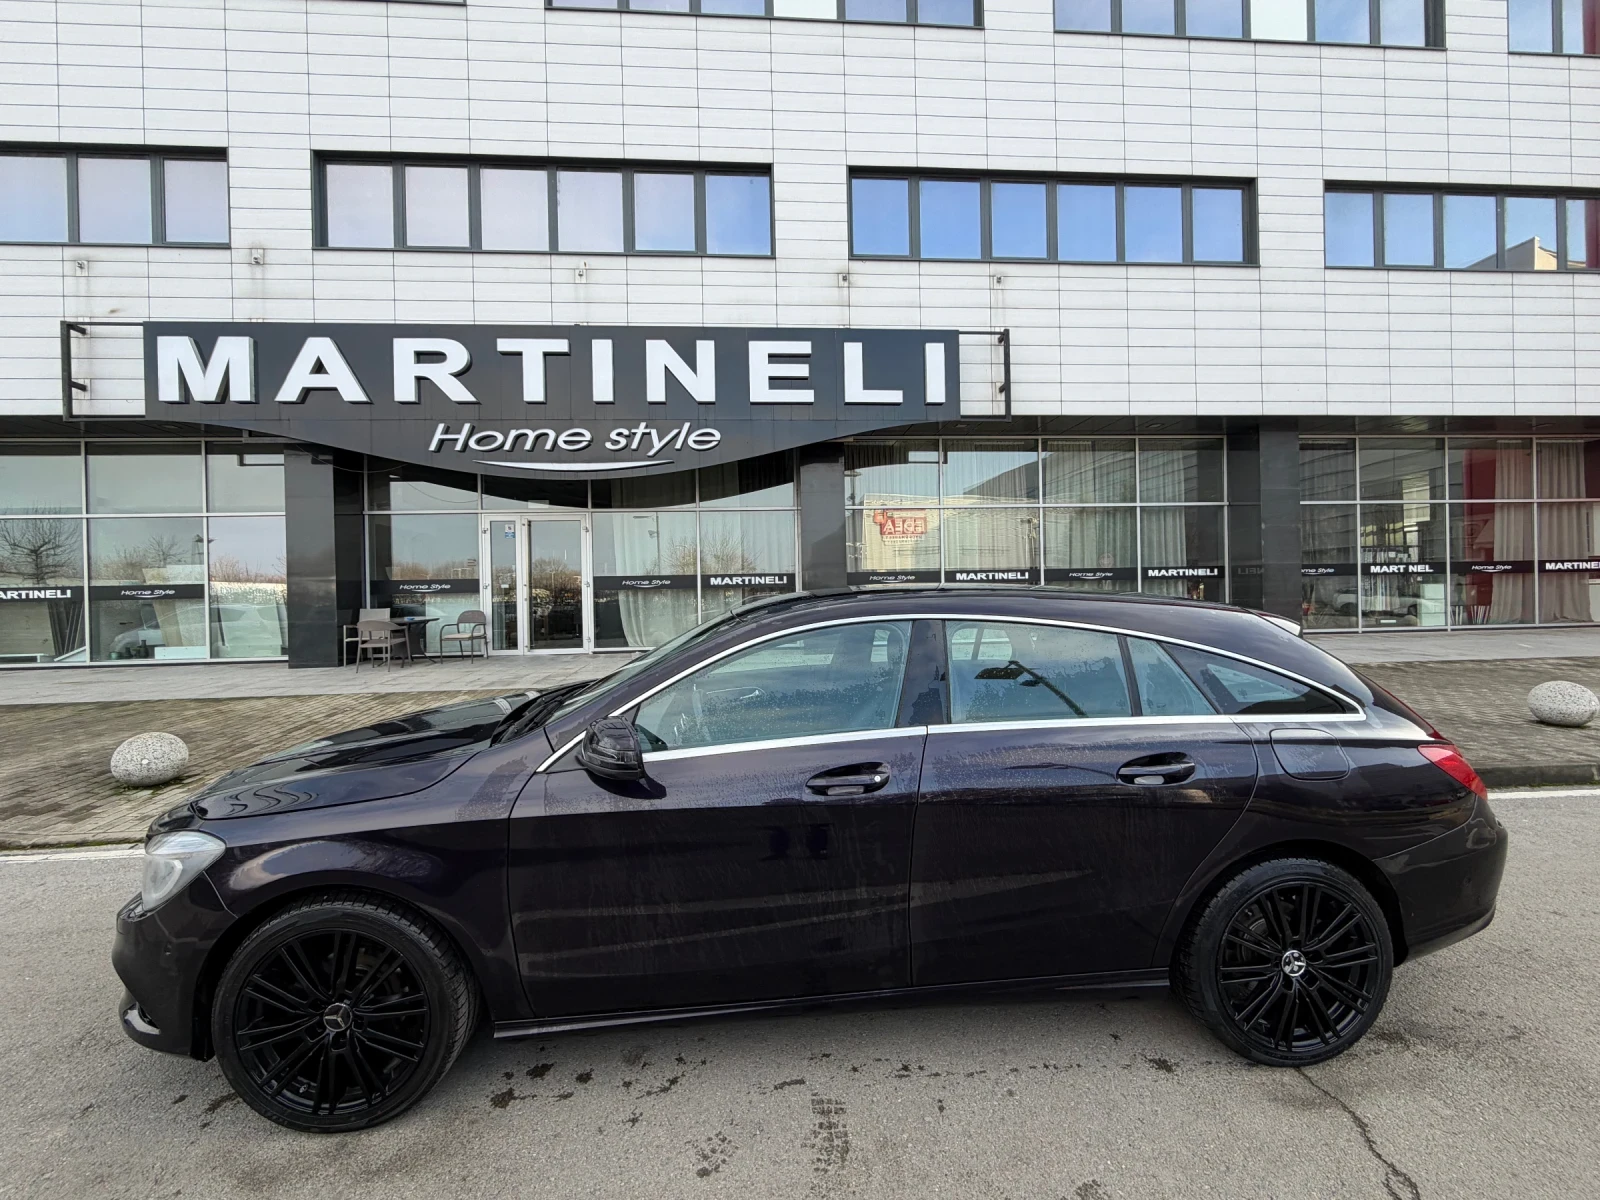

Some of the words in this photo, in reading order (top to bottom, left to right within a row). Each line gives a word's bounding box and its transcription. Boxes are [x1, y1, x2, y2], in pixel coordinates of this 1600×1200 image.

[156, 334, 947, 405] MARTINELI
[428, 422, 592, 452] Home
[604, 421, 722, 457] style
[1545, 561, 1600, 570] MARTINE
[956, 572, 1029, 581] MARTINELI
[1148, 568, 1218, 577] MARTINELI
[710, 575, 788, 585] MARTINELI
[153, 589, 175, 597] Style
